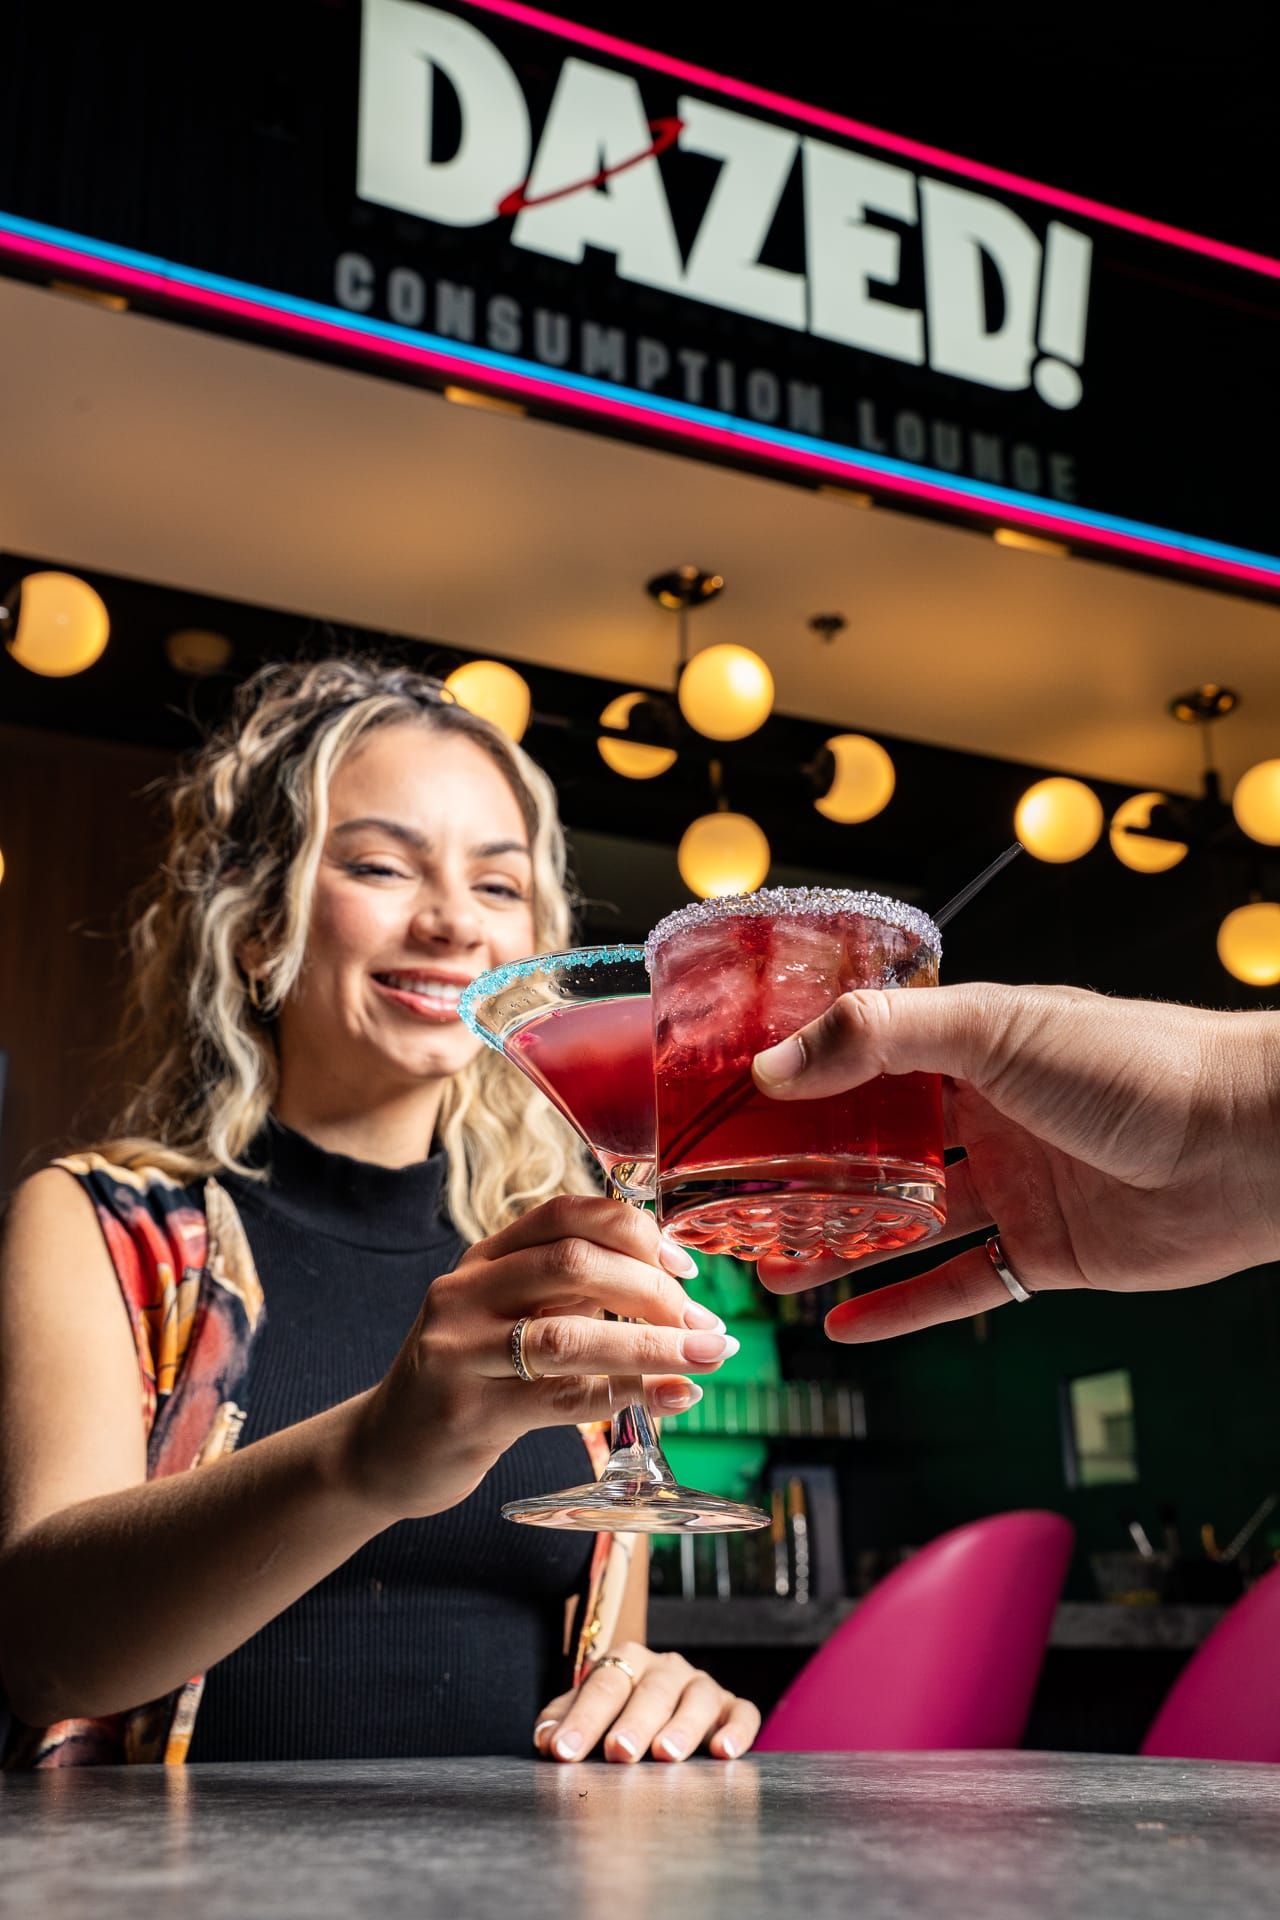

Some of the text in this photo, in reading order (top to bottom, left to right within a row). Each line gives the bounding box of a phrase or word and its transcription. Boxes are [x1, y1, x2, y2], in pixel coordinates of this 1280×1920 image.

[356, 0, 1093, 410] DAZED!
[334, 252, 1078, 502] CONSUMPTION LOUNGE
